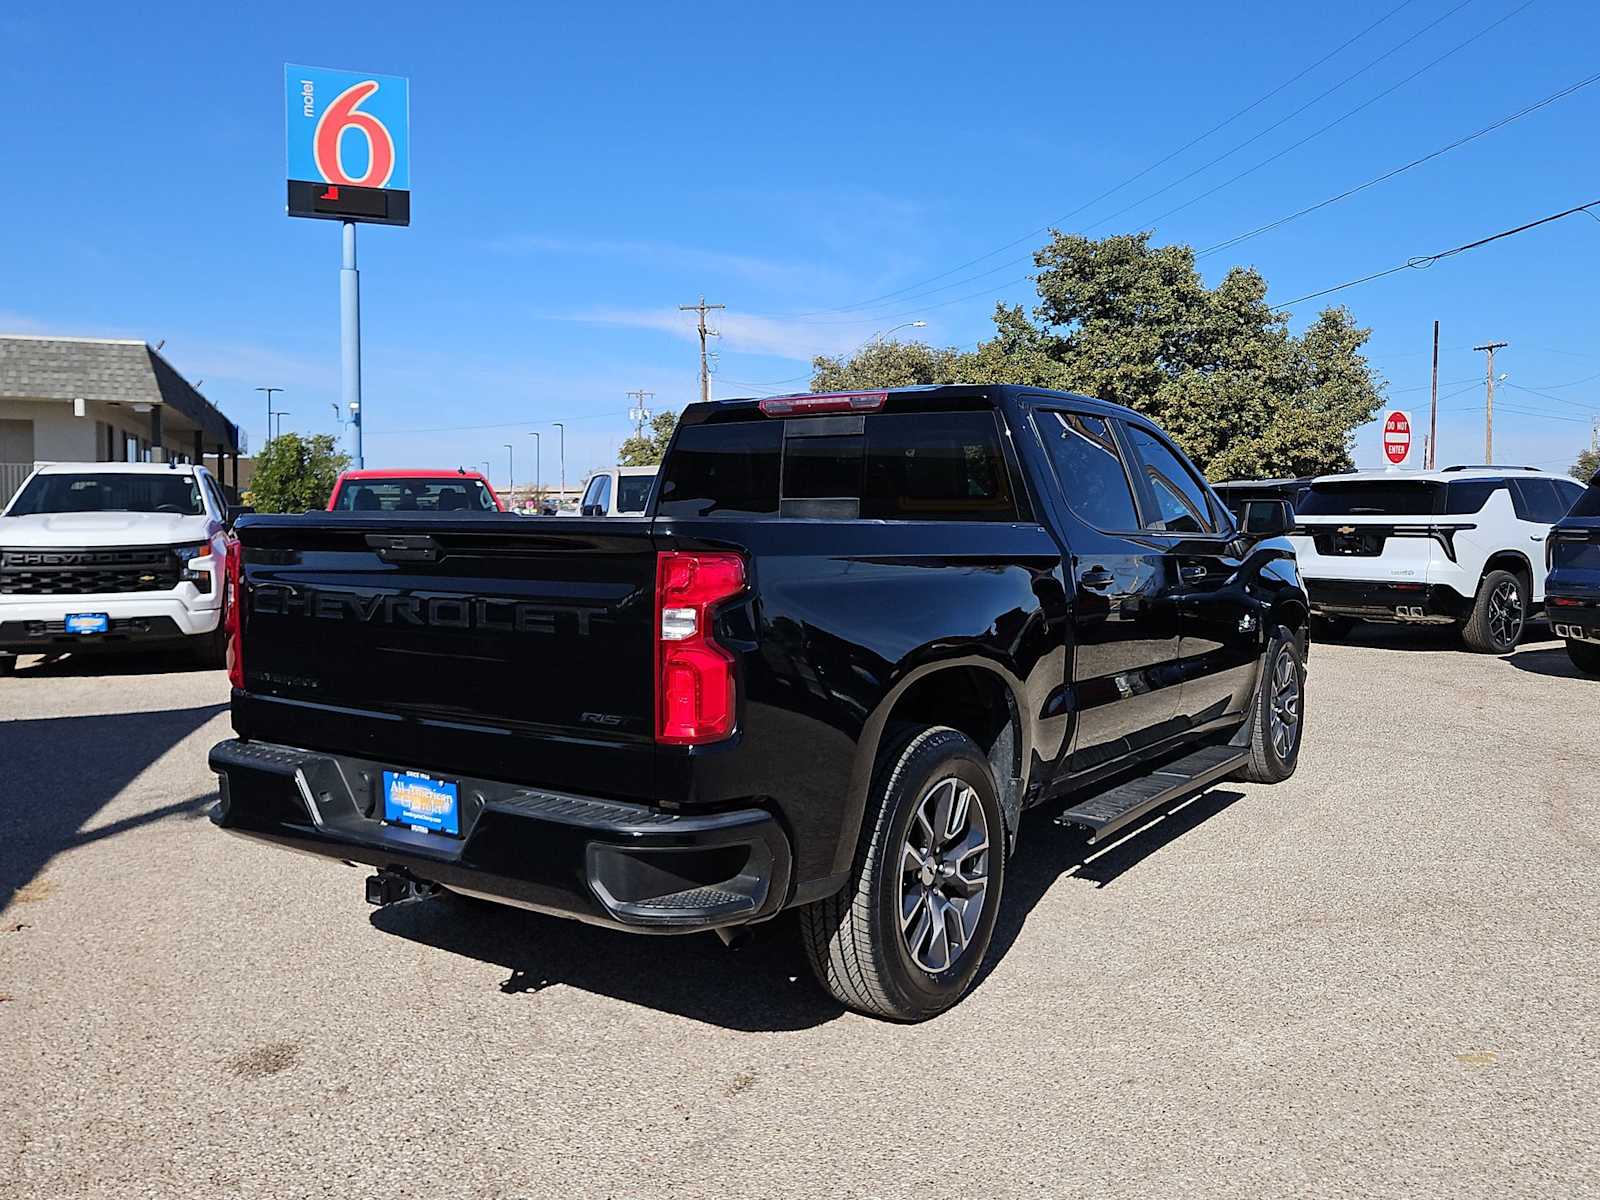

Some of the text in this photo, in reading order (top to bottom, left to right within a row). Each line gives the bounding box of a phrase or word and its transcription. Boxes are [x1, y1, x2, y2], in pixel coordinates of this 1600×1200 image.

[301, 79, 396, 188] motel 6
[1387, 420, 1408, 431] DO NOT
[1388, 445, 1405, 455] ENTER
[251, 586, 608, 636] CHEVROLET
